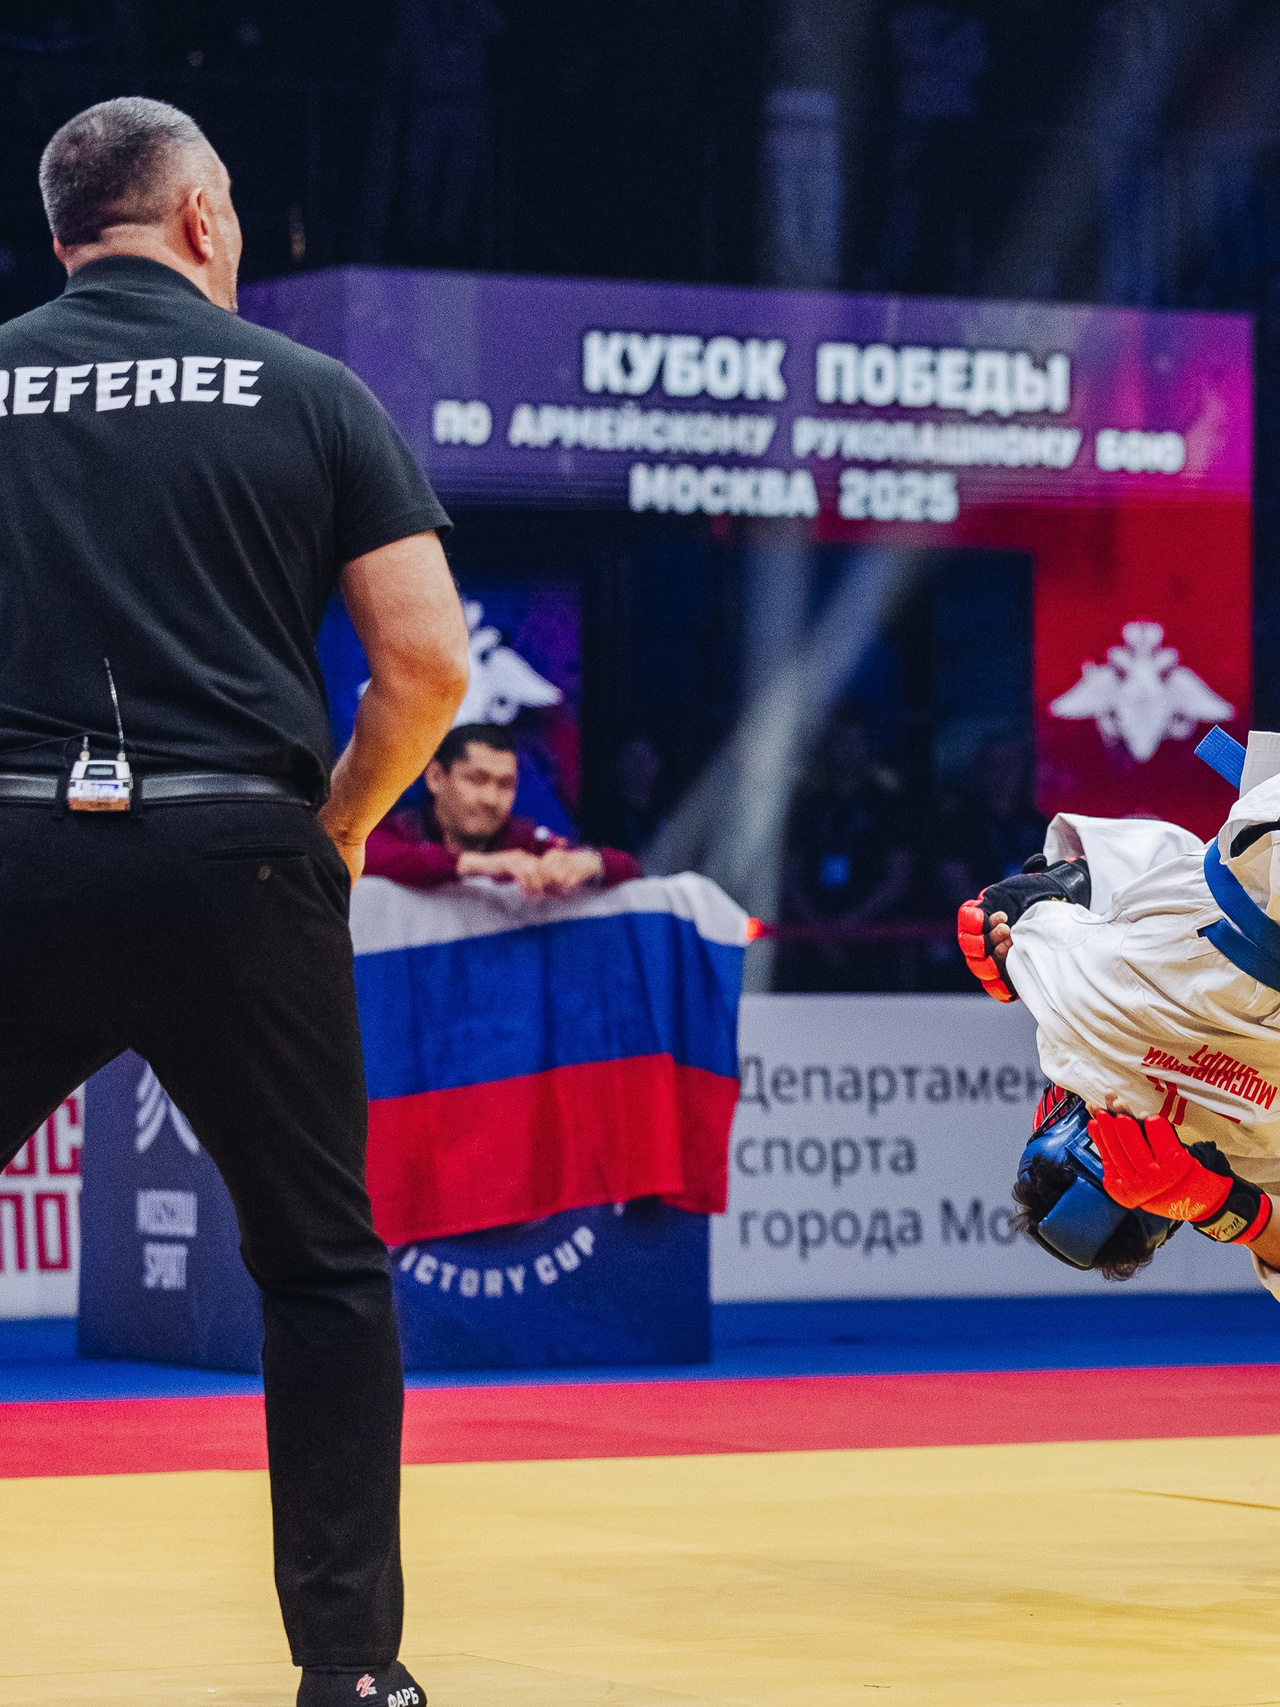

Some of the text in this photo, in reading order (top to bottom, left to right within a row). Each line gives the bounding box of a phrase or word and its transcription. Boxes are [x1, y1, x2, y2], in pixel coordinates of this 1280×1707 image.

[0, 356, 264, 417] EFEREE
[584, 330, 1071, 417] КУБОК ПОБЕДЫ
[433, 400, 1186, 473] ПО АРМЕЙСКОМУ РУКОПАШНОМУ БОЮ
[630, 463, 960, 523] МОСКВА 2025
[739, 1055, 1050, 1117] Департамен
[734, 1132, 917, 1187] спорта
[738, 1198, 1030, 1262] города Мо
[400, 1226, 596, 1298] ICTORY CUP
[387, 1686, 420, 1707] ФАРБ
